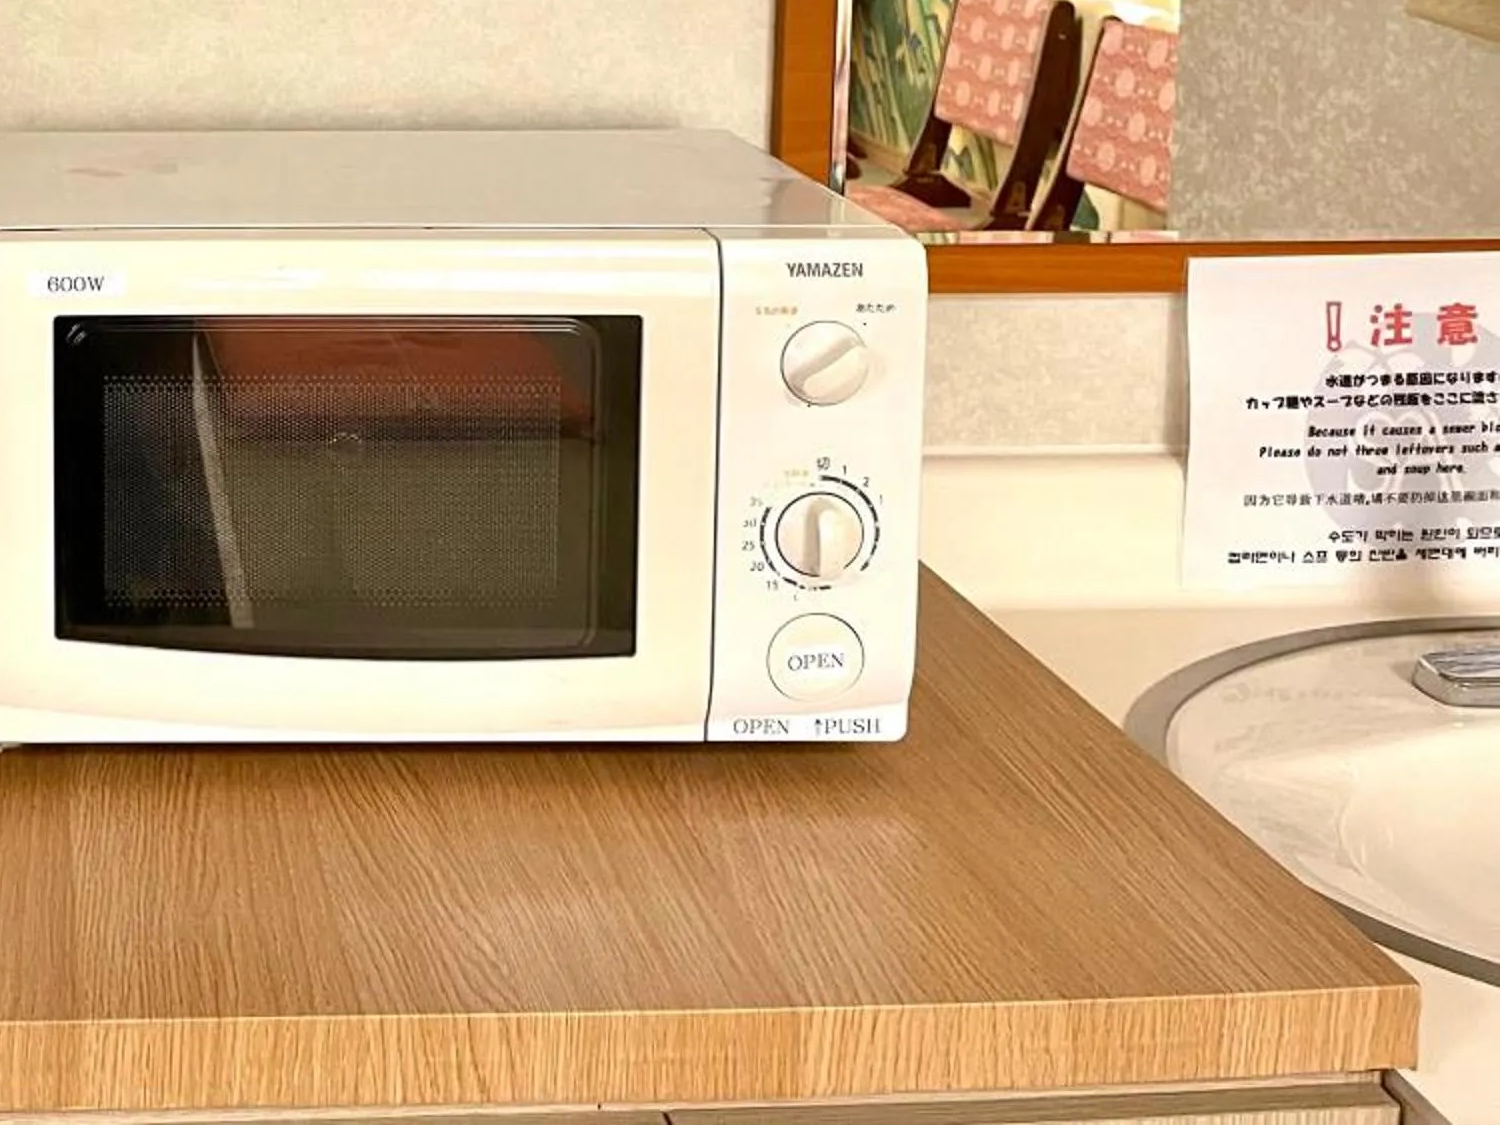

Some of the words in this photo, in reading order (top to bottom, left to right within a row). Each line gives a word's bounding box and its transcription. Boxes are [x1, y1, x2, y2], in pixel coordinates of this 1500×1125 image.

[786, 262, 864, 278] YAMAZEN
[47, 275, 105, 292] 600W
[1307, 425, 1356, 438] Because
[1363, 424, 1376, 437] it
[1382, 426, 1423, 436] causes
[1259, 446, 1301, 458] Please
[1307, 445, 1322, 458] do
[1327, 445, 1348, 457] not
[1396, 441, 1455, 455] leftovers
[1461, 441, 1489, 454] such
[1376, 463, 1397, 475] and
[1404, 464, 1431, 475] soup
[862, 476, 871, 488] 2
[741, 540, 756, 551] 25
[749, 561, 765, 572] 20
[787, 653, 846, 672] OPEN
[733, 719, 791, 735] OPEN
[824, 718, 882, 735] PUSH
